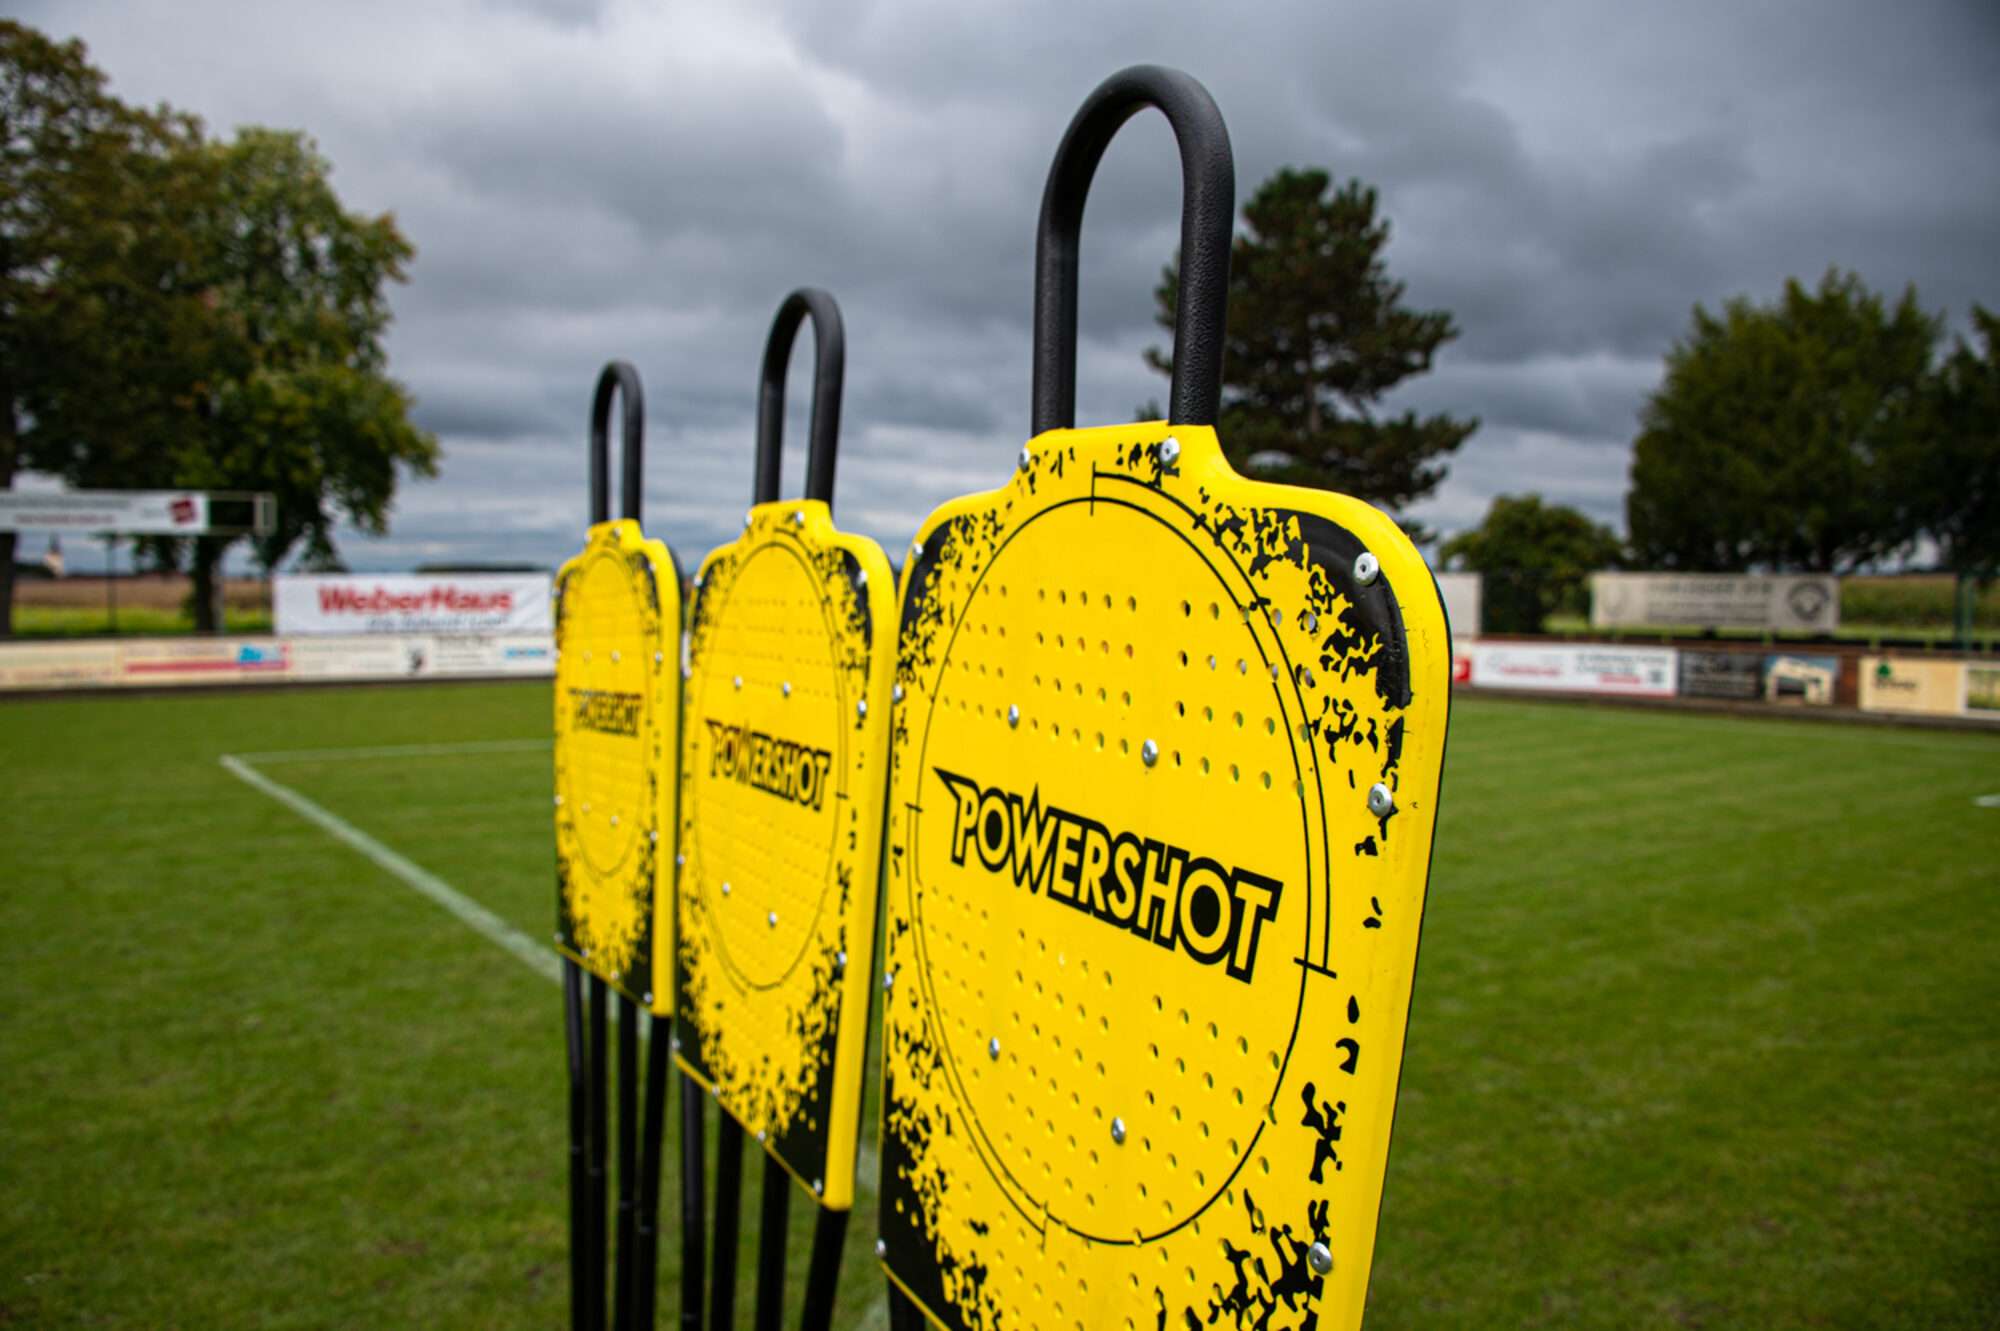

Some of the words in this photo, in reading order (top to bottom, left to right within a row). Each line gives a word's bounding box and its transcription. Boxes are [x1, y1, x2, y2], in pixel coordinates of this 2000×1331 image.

[319, 586, 513, 614] WeberHaus
[705, 719, 831, 812] POWERSHOT
[932, 767, 1284, 984] POWERSHOT
